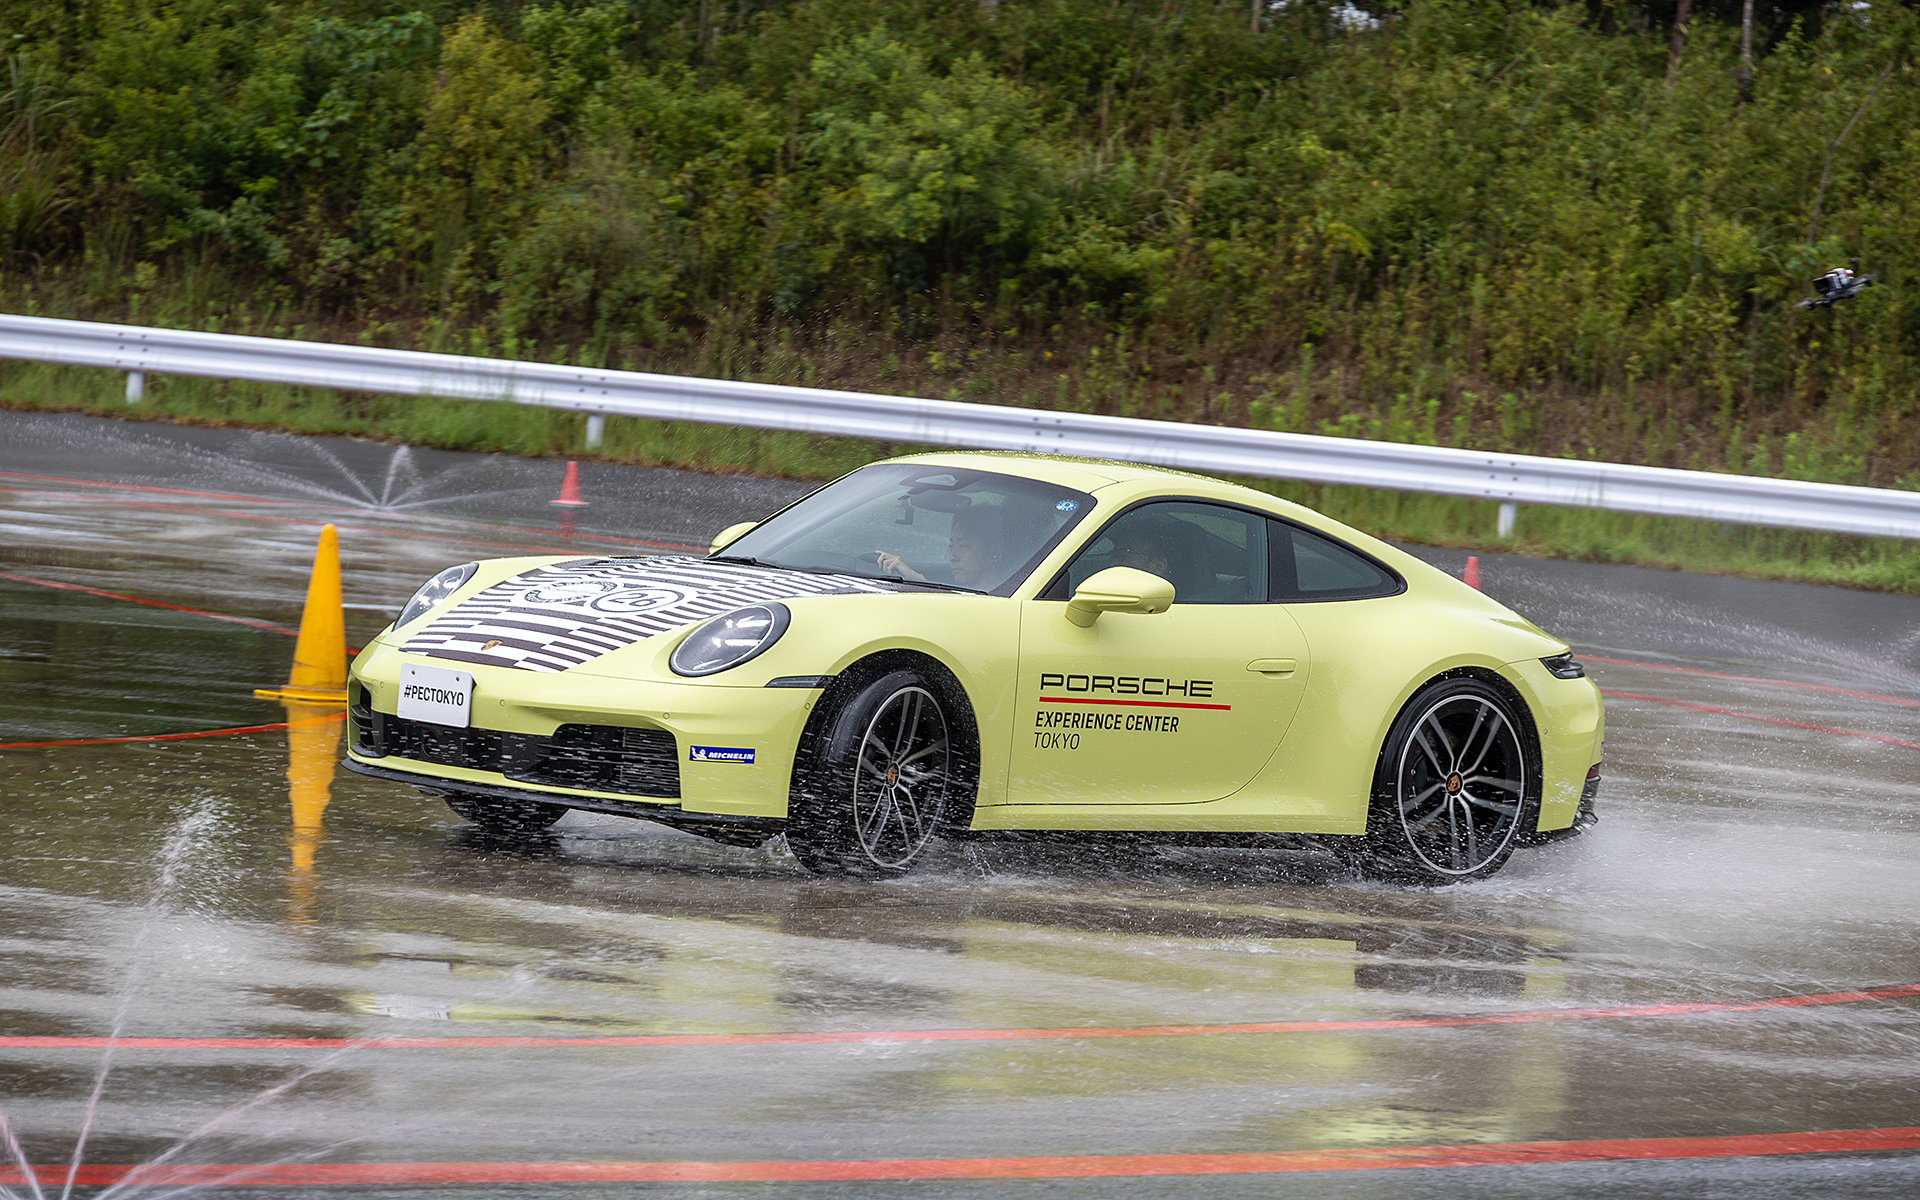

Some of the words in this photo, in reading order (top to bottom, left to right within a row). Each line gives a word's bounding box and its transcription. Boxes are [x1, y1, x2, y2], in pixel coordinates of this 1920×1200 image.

[403, 684, 464, 707] #PECTOKYO
[1041, 673, 1213, 697] PORSCHE
[1035, 711, 1123, 730] EXPERIENCE
[1125, 714, 1180, 733] CENTER
[1034, 732, 1080, 750] TOKYO
[708, 751, 755, 760] MICHELIN
